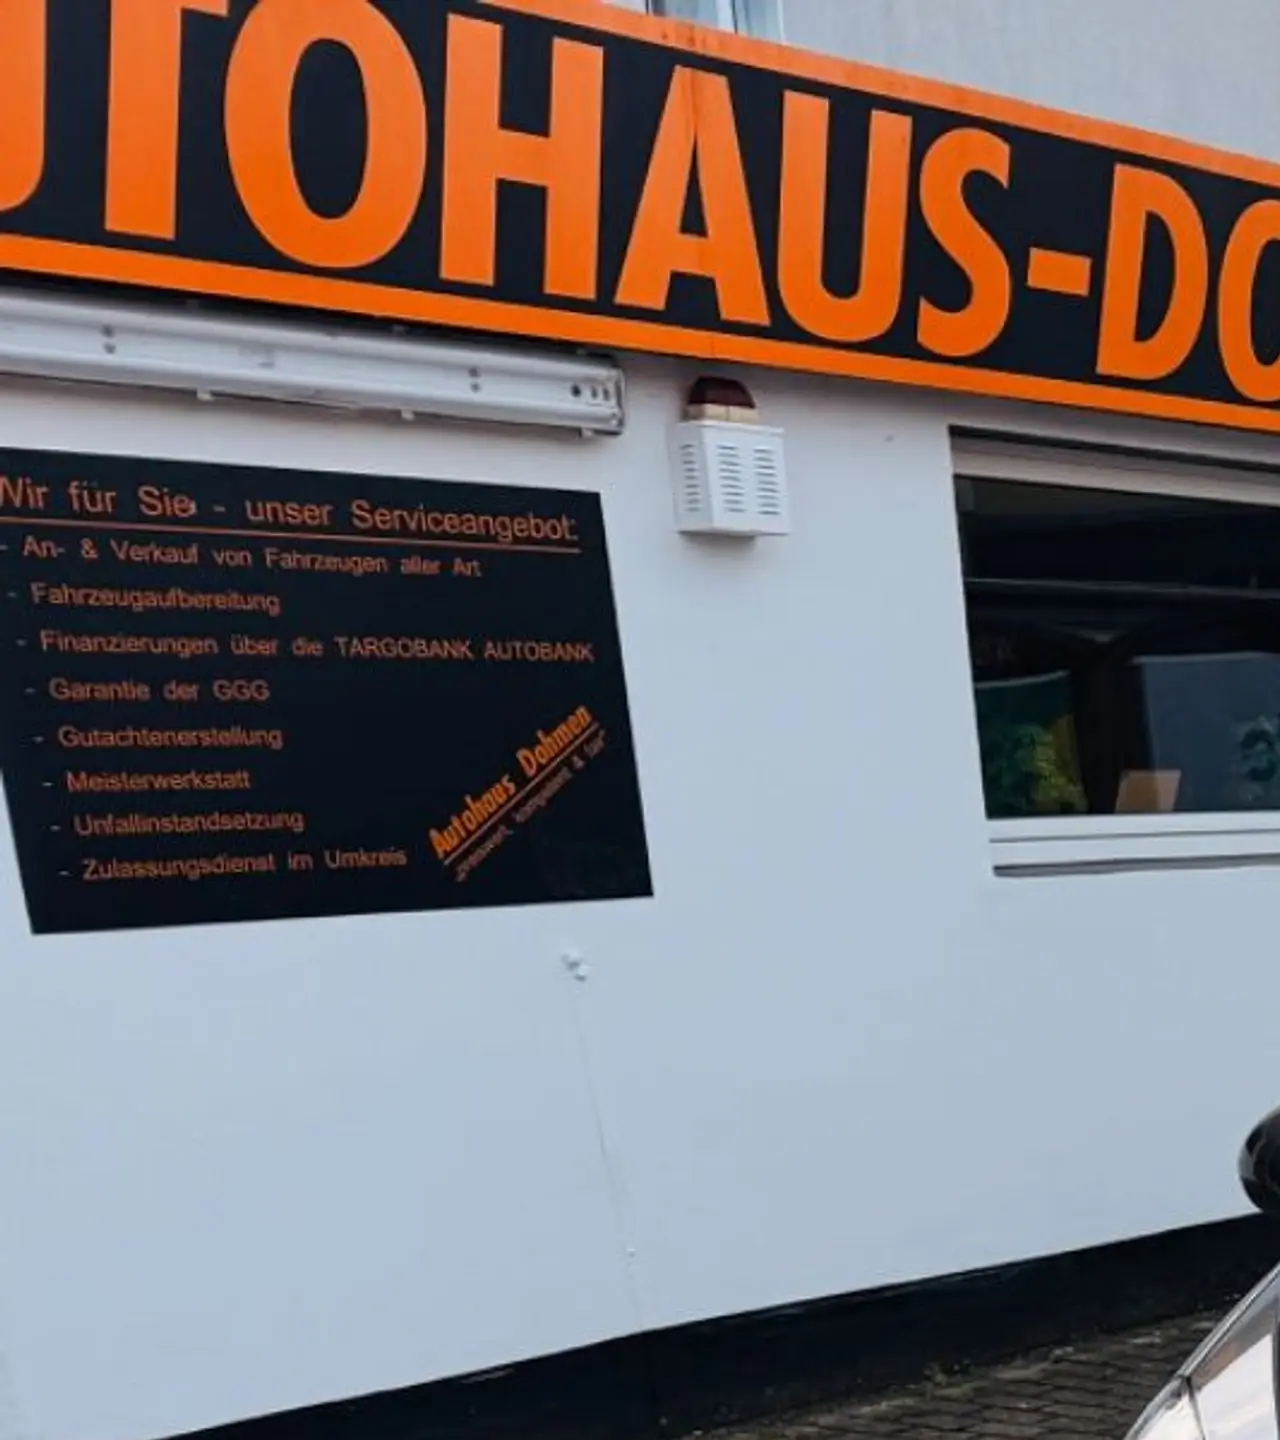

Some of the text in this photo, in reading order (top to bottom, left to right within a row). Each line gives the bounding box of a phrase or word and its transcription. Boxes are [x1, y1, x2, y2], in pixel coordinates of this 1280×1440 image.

[68, 479, 117, 513] für
[245, 499, 334, 526] unser
[351, 498, 579, 543] Serviceangebot:
[110, 538, 199, 565] Verkauf
[212, 547, 252, 567] von
[265, 546, 389, 577] Fahrzeugen
[400, 555, 441, 576] aller
[453, 557, 482, 578] Art
[30, 582, 281, 617] Fahrzeugaufbereitung
[40, 629, 595, 664] Finanzierungen über die TARGOBANK AUTOBANK
[49, 676, 271, 702] Garantie der GGG
[57, 724, 284, 750] Gutachtenerstellung
[66, 768, 251, 793] Meisterwerkstatt
[429, 773, 516, 861] Autohaus
[515, 704, 594, 777] Dohmen
[74, 810, 305, 837] Unfallinstandsetzung
[83, 852, 276, 881] Zulassungsdienst
[324, 845, 407, 870] Umkreis
